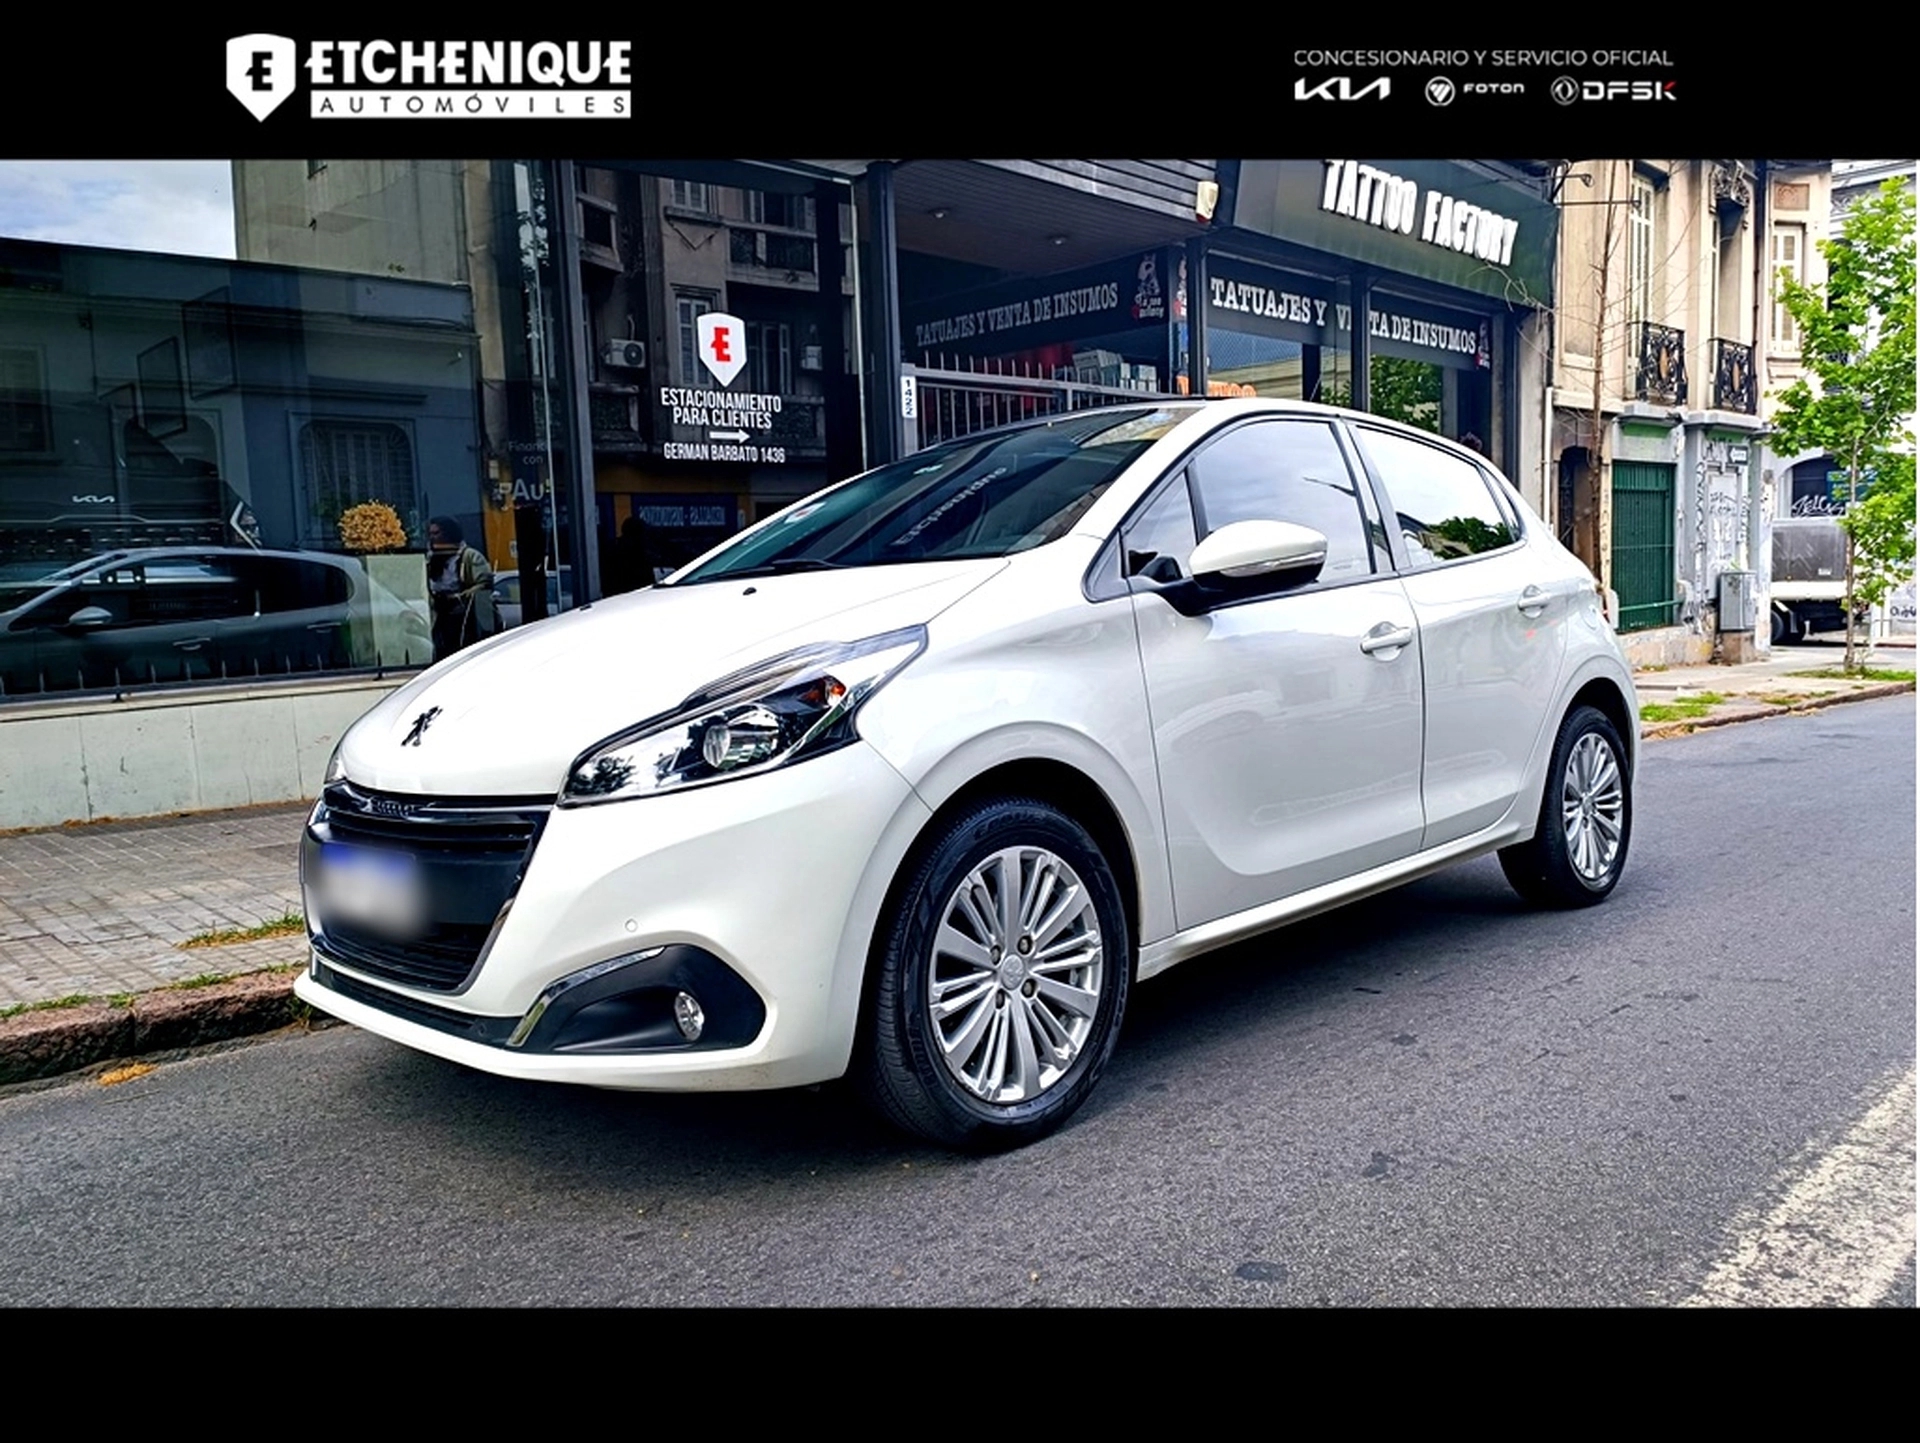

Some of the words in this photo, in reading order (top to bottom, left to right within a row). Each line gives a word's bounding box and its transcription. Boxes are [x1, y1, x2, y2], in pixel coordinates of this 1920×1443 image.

[1321, 158, 1418, 235] TATTOO
[1421, 190, 1519, 266] FACTORY
[915, 313, 977, 347] TATUAJES
[977, 310, 987, 334] Y
[987, 302, 1032, 332] VENTA
[1033, 296, 1051, 322] DE
[1053, 282, 1119, 319] INSUMOS
[1210, 277, 1311, 324] TATUAJES
[1314, 300, 1328, 327] Y
[1391, 315, 1411, 342] DE
[1412, 319, 1476, 355] INSUMOS
[660, 387, 782, 413] ESTACIONAMIENTO
[673, 407, 710, 426] PARA
[712, 409, 772, 429] CLIENTES
[663, 443, 710, 461] GERMAN
[711, 444, 759, 462] BARBATO
[761, 446, 785, 463] 1436
